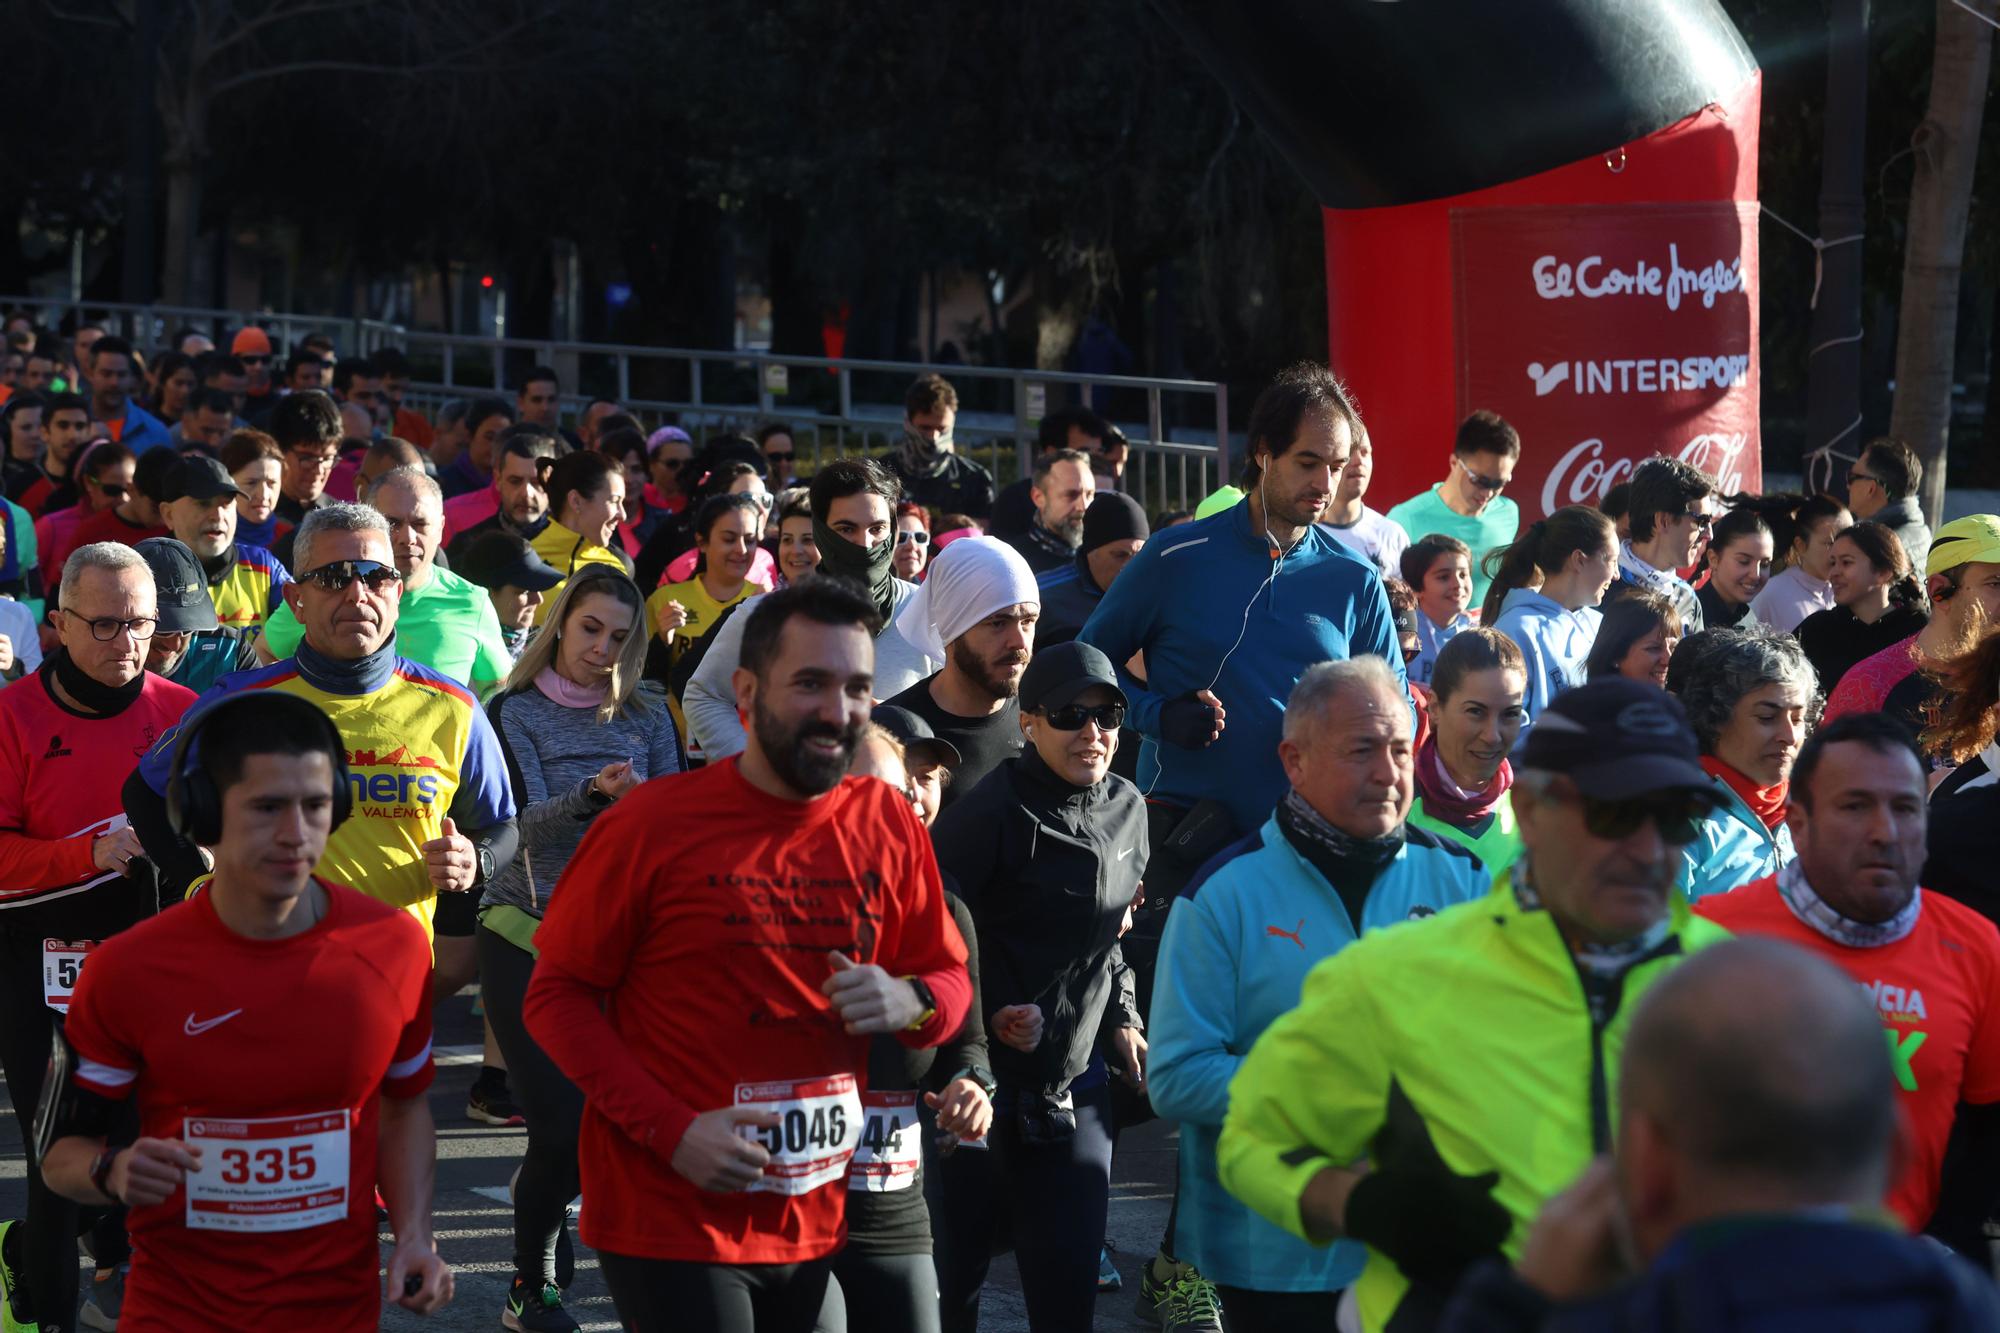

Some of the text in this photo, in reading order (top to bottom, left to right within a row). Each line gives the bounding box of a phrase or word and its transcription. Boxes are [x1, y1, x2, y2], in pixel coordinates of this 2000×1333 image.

[1533, 243, 1746, 311] El Corte Inglés
[1574, 355, 1748, 394] INTERSPORT
[757, 1105, 846, 1154] 5046
[221, 1144, 316, 1184] 335
